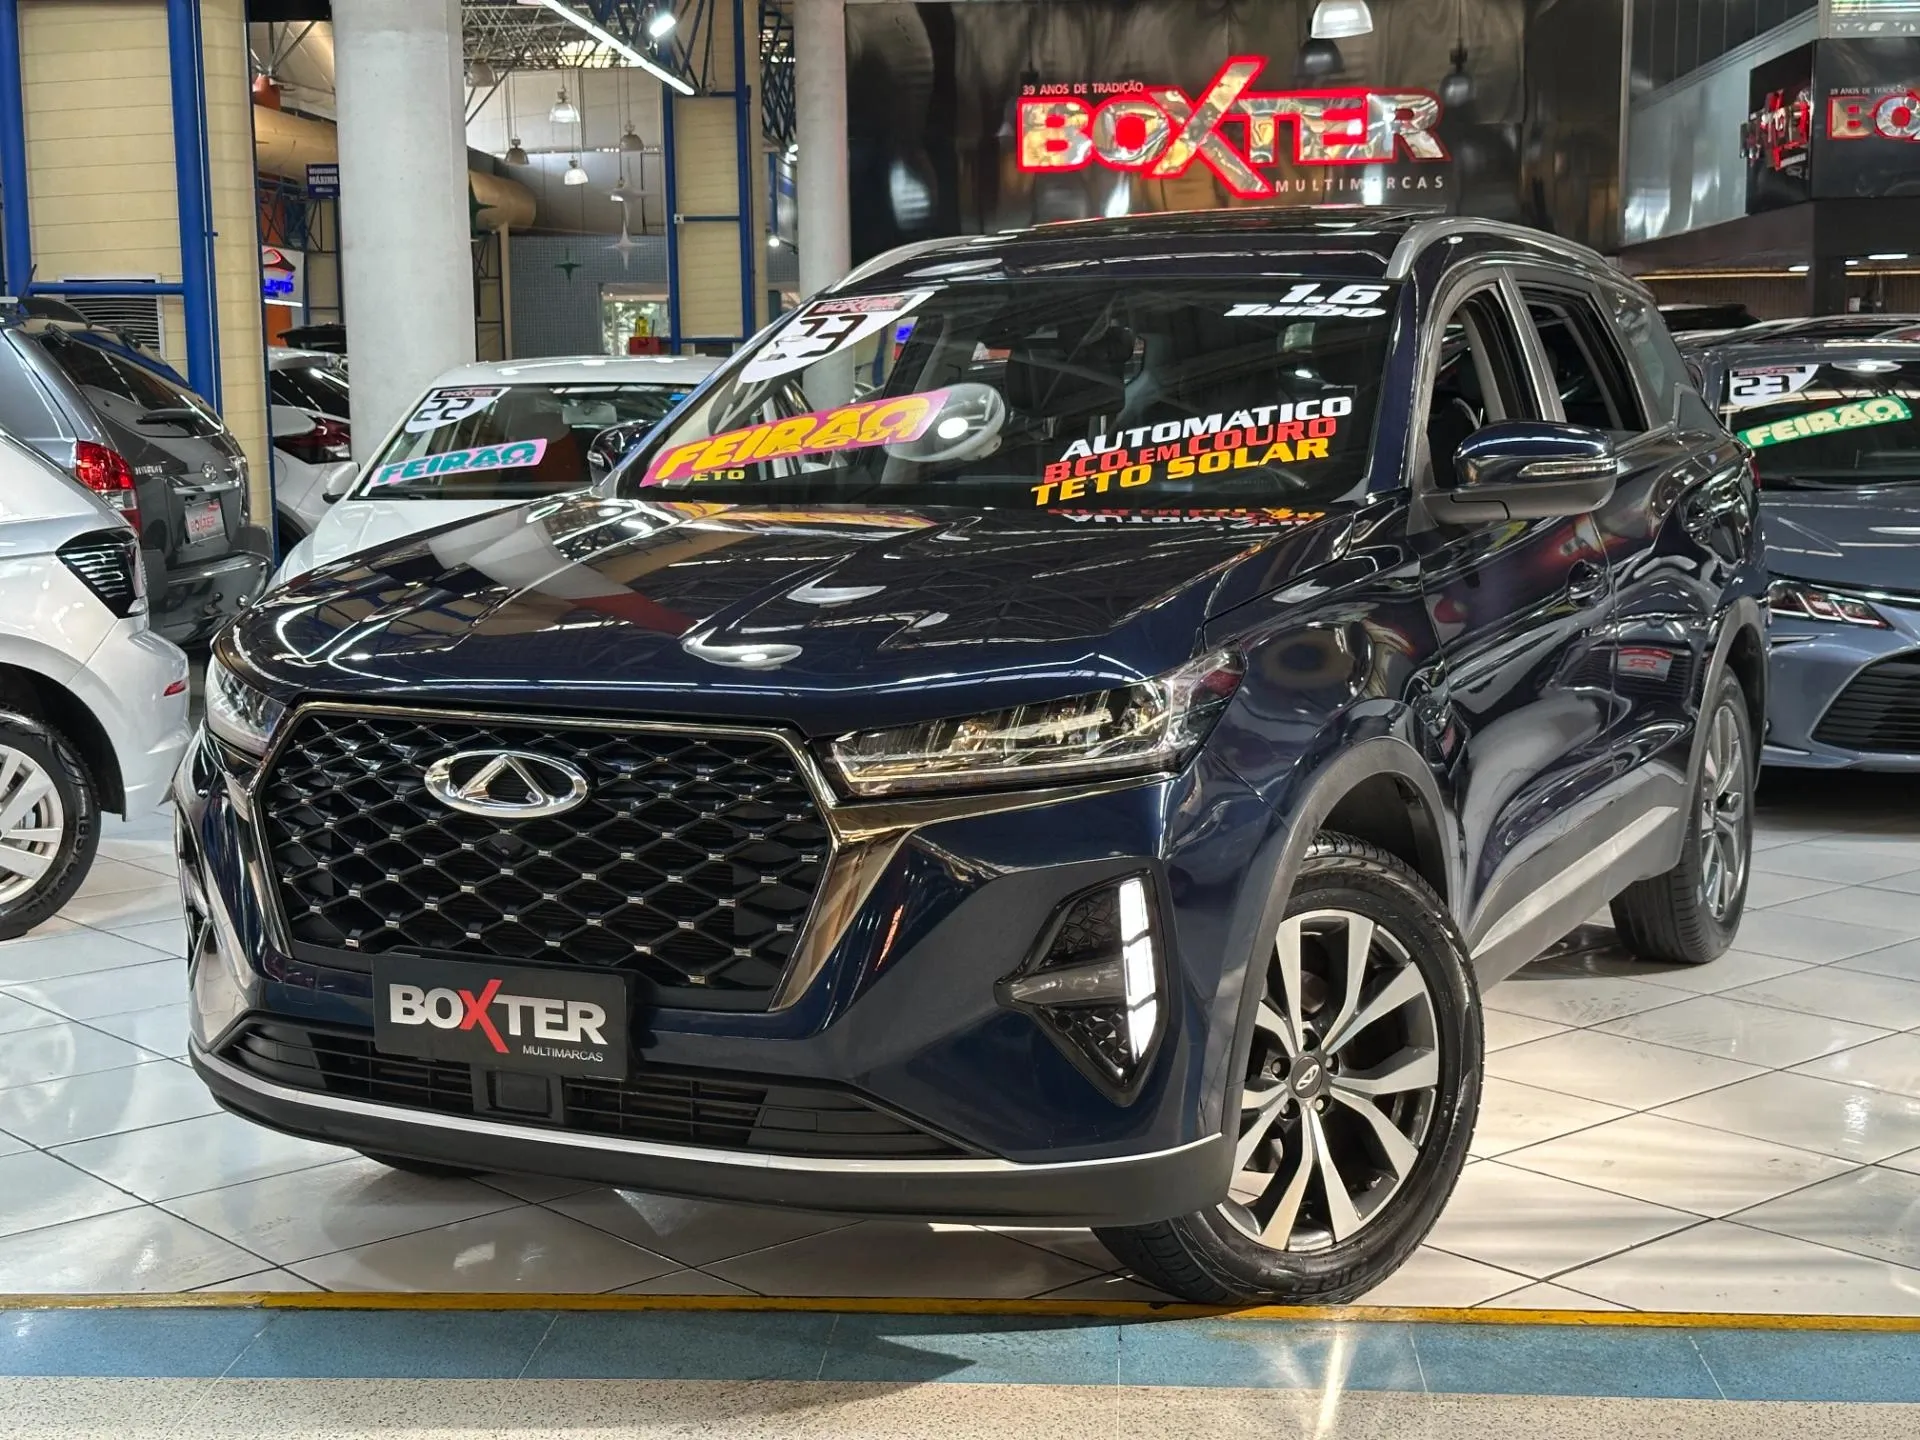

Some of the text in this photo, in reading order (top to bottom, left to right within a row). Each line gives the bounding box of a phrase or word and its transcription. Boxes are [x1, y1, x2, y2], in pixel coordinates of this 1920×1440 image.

[1022, 79, 1144, 96] 39 ANOS DE TRADIÇÃO
[1017, 56, 1452, 199] BOXTER
[1827, 89, 1920, 143] BO
[1279, 283, 1391, 305] 1.6
[1733, 374, 1791, 397] 23
[412, 398, 475, 423] 22
[1060, 396, 1352, 462] AUTOMÁTICO
[1747, 399, 1905, 446] FEIRÃO
[655, 397, 930, 480] FEIRÃO
[1139, 443, 1181, 465] EM
[1188, 417, 1337, 454] COURO
[378, 442, 537, 483] FEIRÃO
[1031, 438, 1329, 506] TETO SOLAR
[389, 979, 608, 1054] BOXTER
[523, 1044, 604, 1063] MULTIMARCAS
